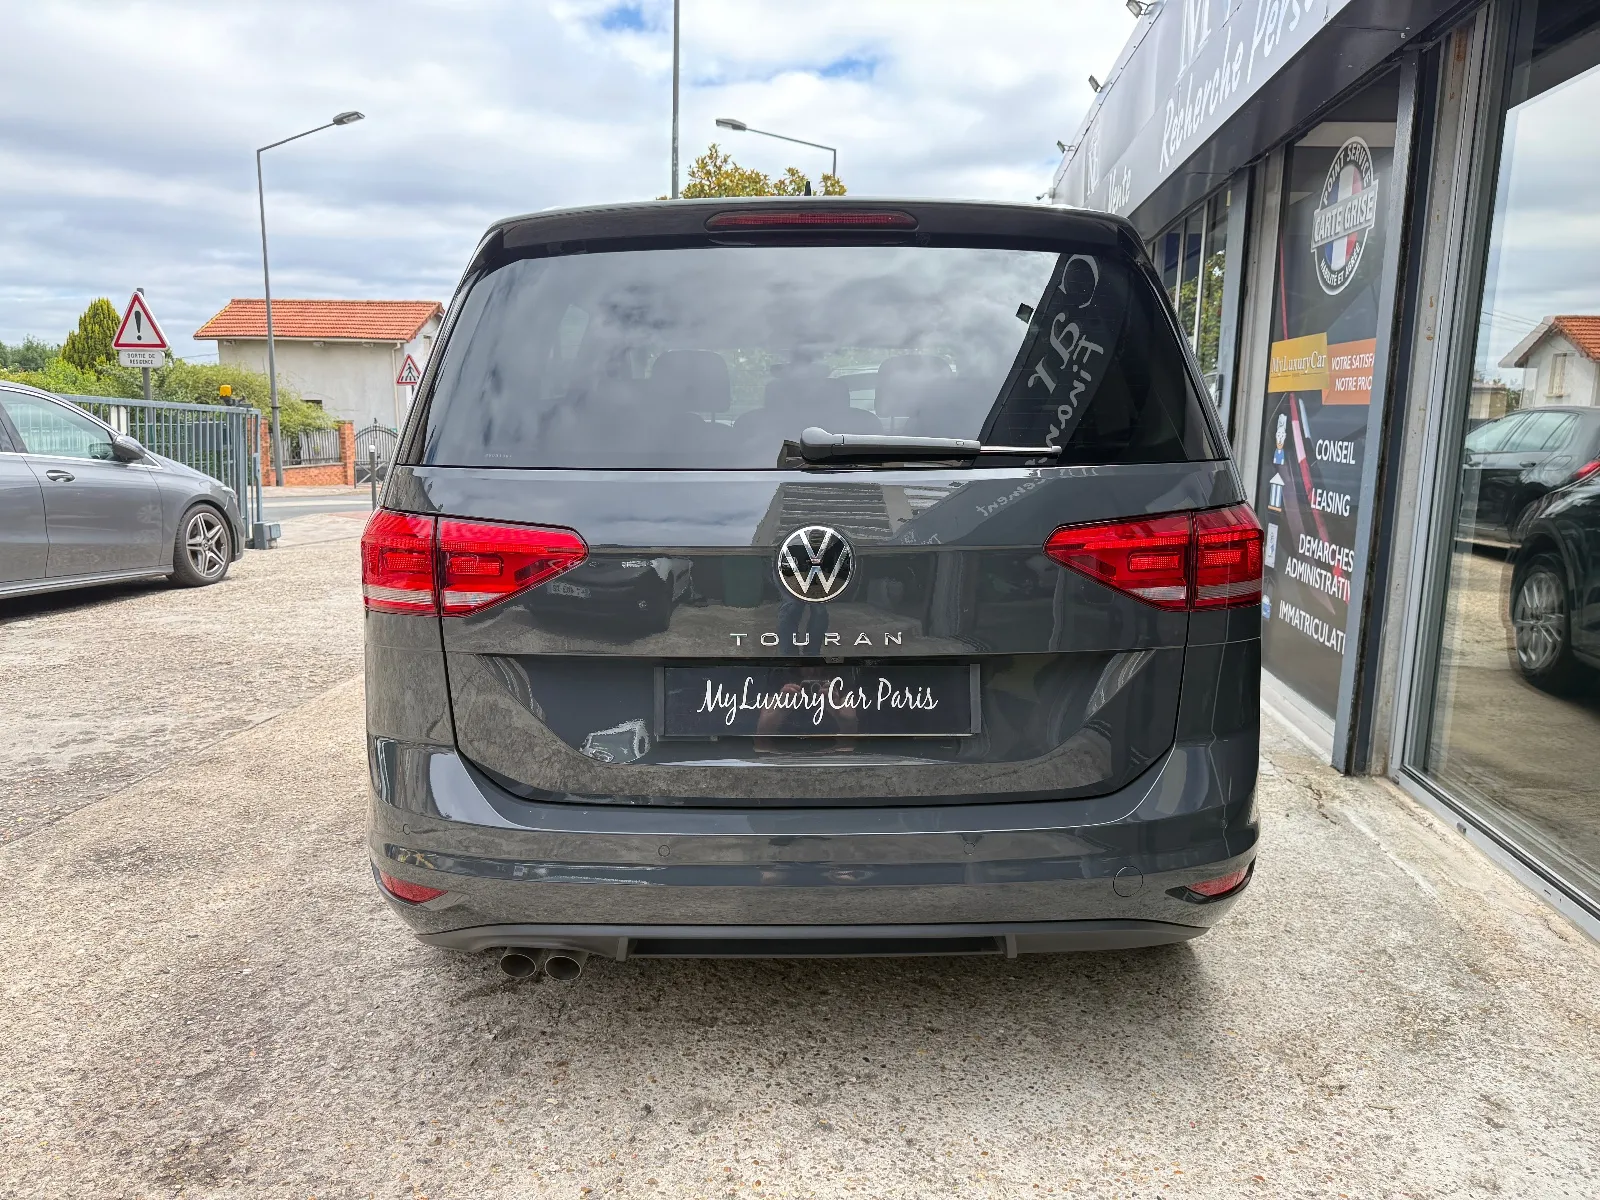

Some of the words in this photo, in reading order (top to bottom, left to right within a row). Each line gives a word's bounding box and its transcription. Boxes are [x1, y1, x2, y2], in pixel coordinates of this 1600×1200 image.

[1159, 26, 1244, 173] Recherche
[1247, 0, 1313, 84] Pers
[1323, 152, 1345, 204] POINT
[1347, 143, 1371, 187] SERVICE
[1314, 207, 1343, 243] CARTE
[1344, 190, 1376, 230] GRISE
[1337, 270, 1345, 285] ET
[1271, 350, 1327, 377] MyLuxuryCar
[1331, 355, 1352, 371] VOTRE
[1334, 377, 1357, 392] NOTRE
[1315, 439, 1356, 465] CONSEIL
[1310, 487, 1351, 518] LEASING
[1298, 533, 1355, 573] DEMARCHES
[729, 631, 903, 647] TOURAN
[1279, 599, 1346, 655] IMMATRICULATI
[697, 676, 873, 725] MyLuxuryCar
[876, 676, 939, 712] Paris
